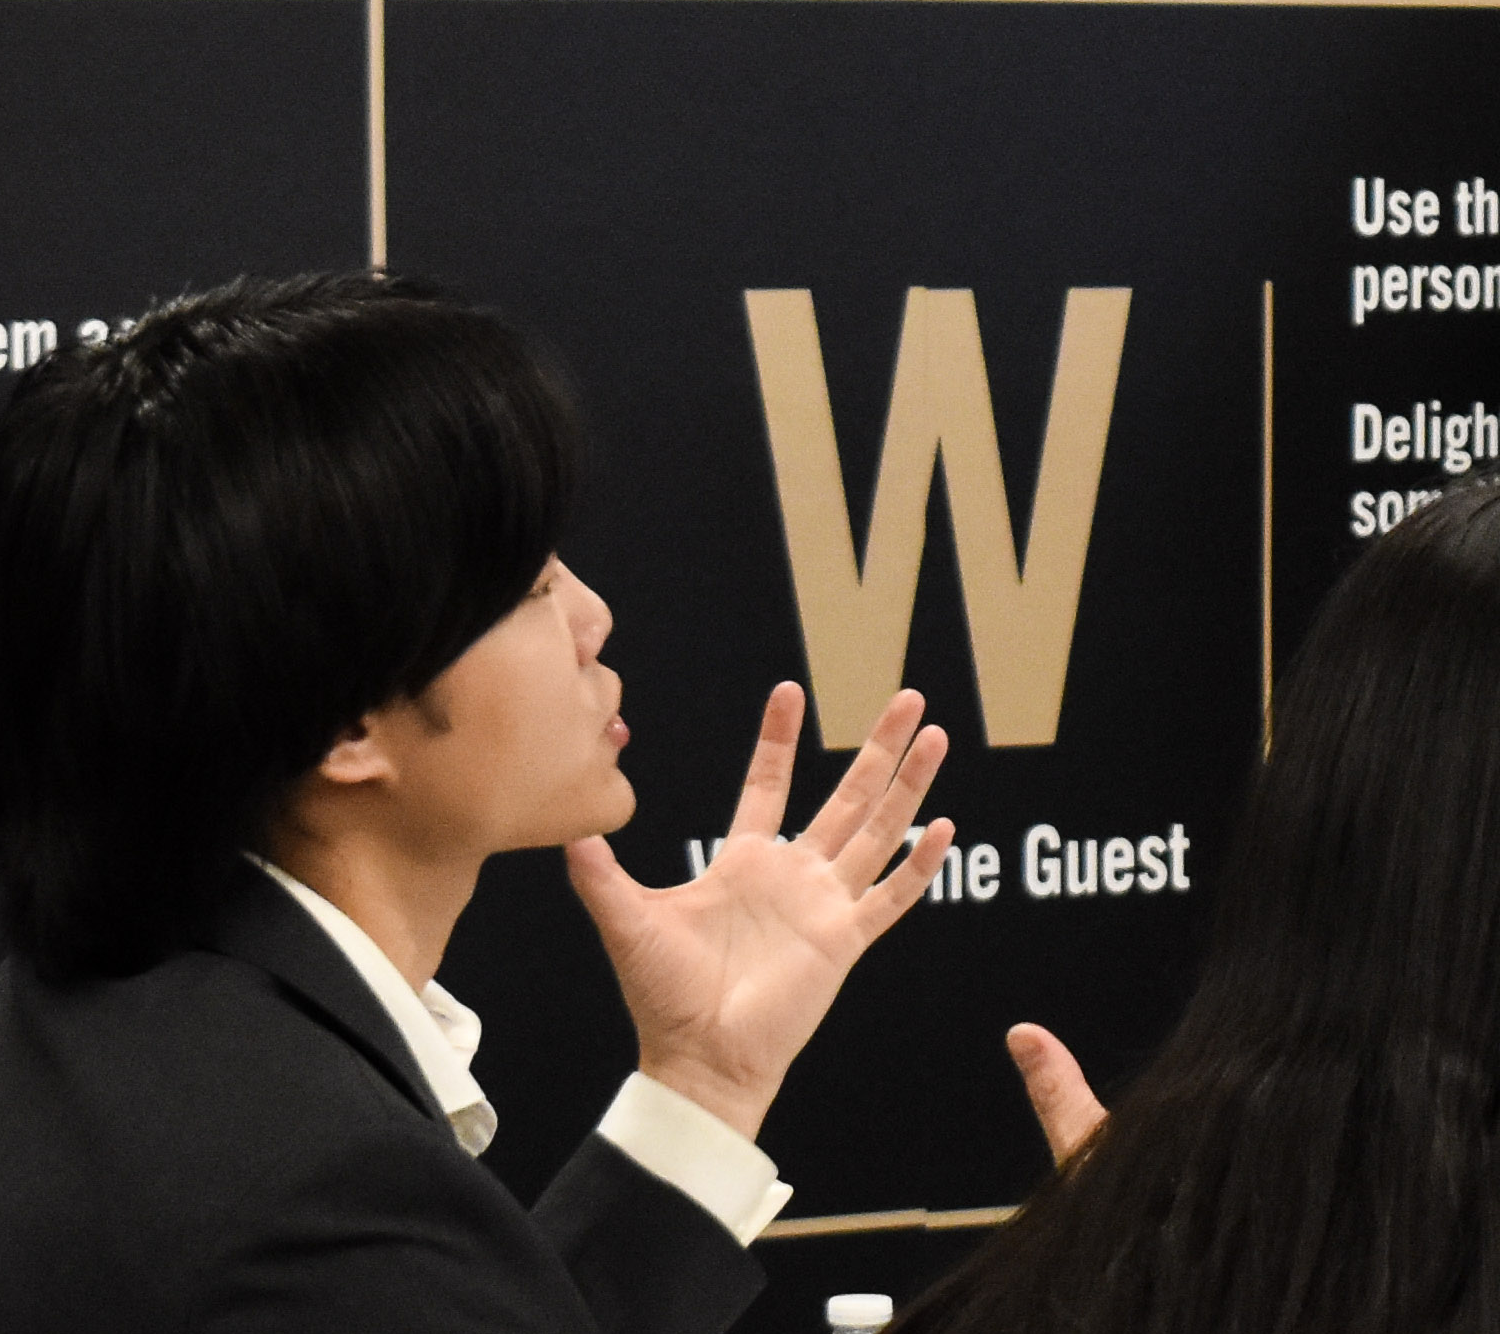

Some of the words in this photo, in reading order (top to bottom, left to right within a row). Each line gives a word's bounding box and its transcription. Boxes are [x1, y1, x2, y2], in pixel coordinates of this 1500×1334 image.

[1352, 176, 1440, 237] Use
[743, 285, 1134, 751] W
[1022, 823, 1191, 899] Guest
